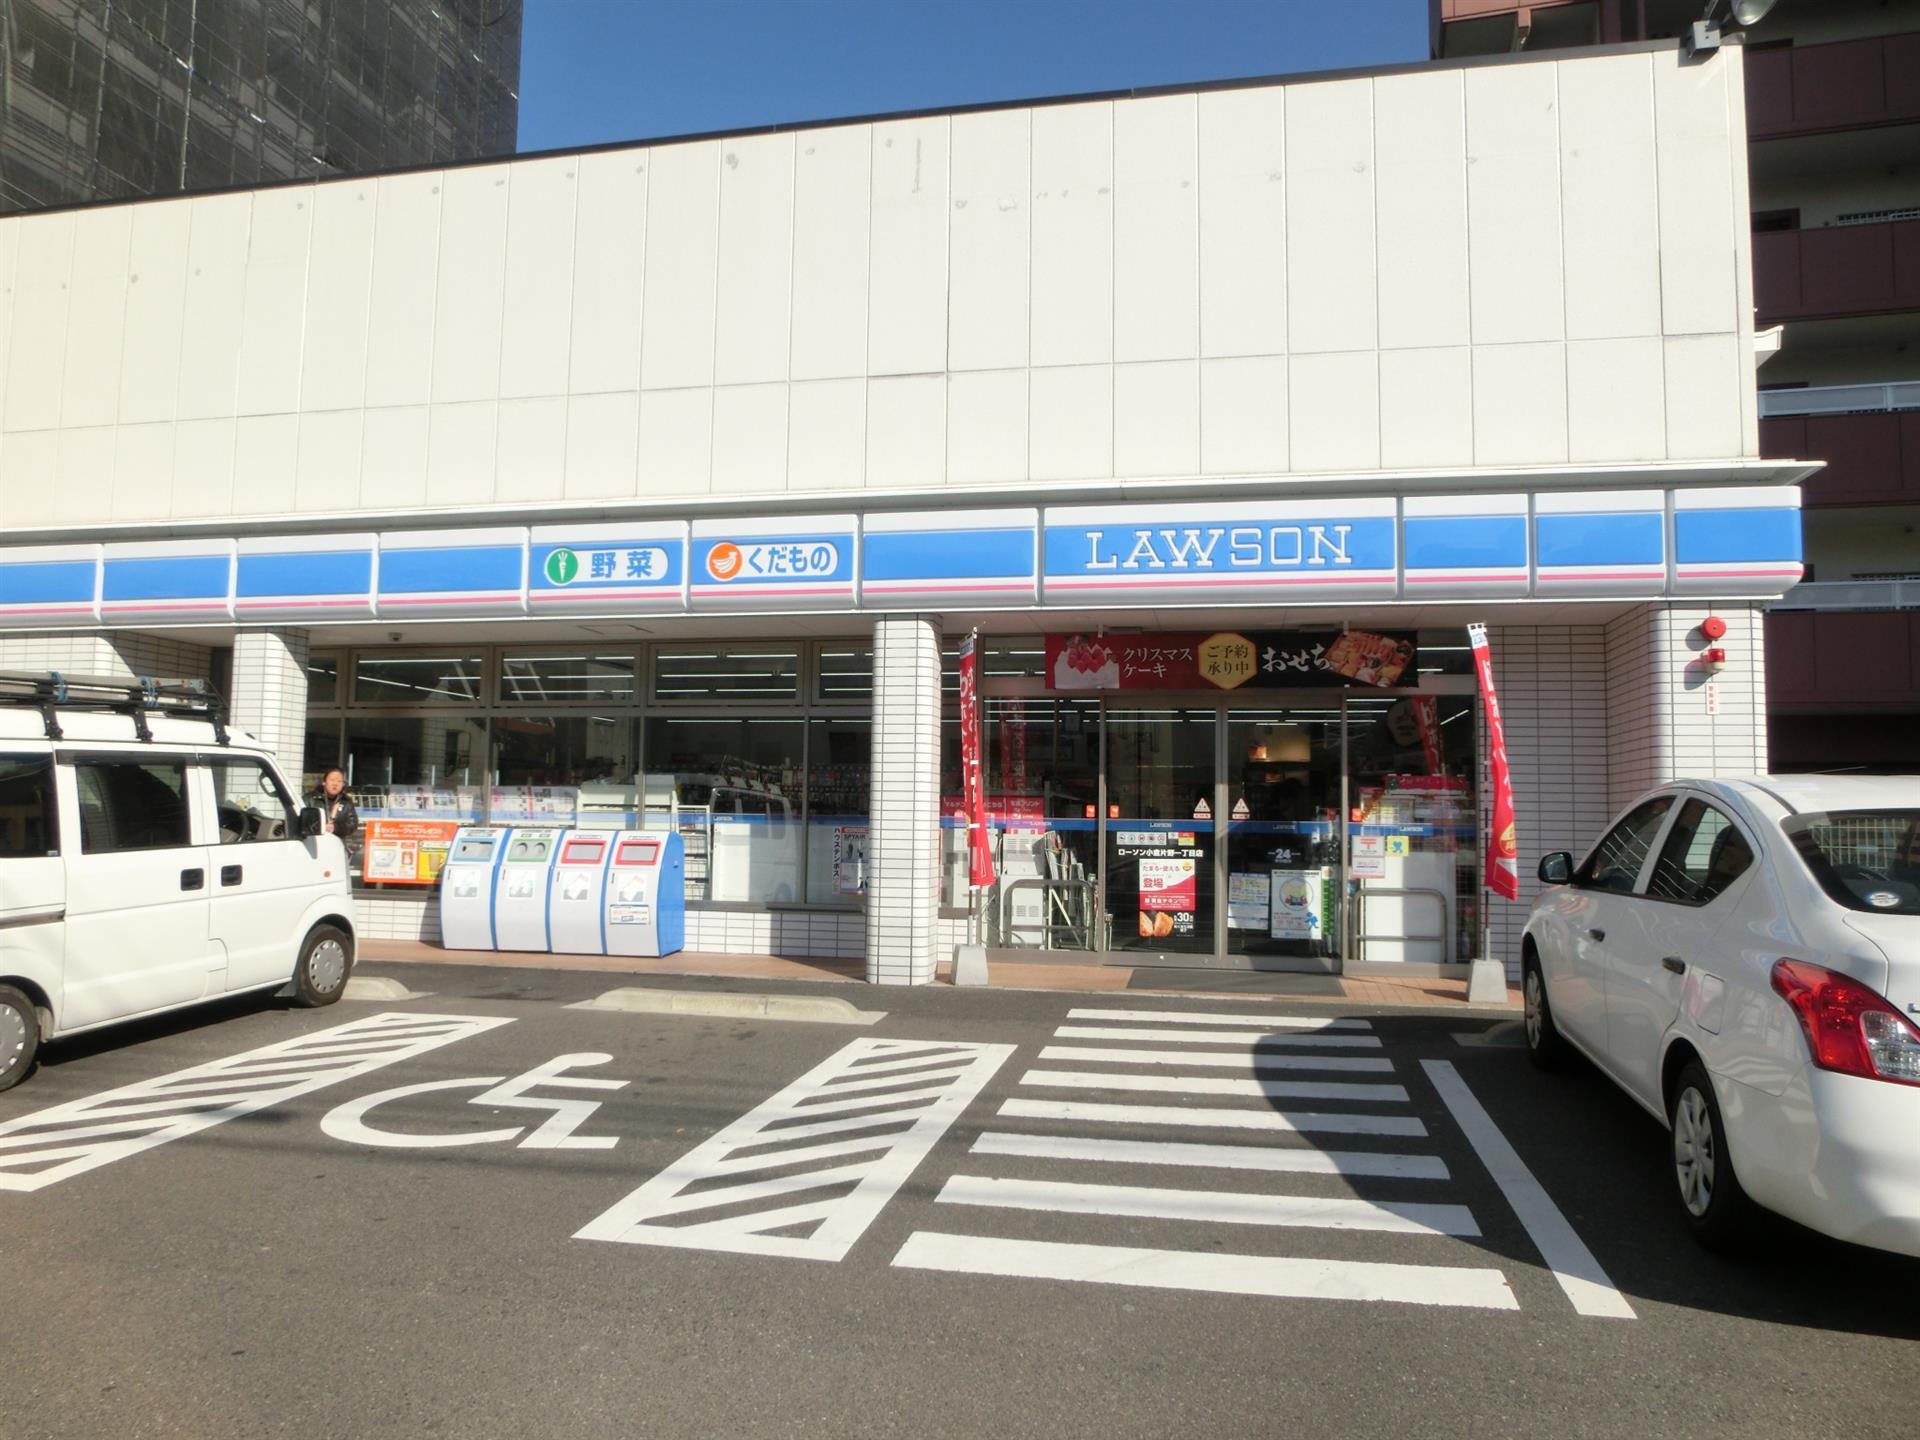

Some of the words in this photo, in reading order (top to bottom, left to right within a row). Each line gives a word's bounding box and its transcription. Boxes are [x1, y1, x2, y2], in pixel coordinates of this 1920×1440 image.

[1085, 525, 1352, 570] LAWSON
[590, 550, 653, 579] 野菜
[748, 546, 831, 574] くだもの
[1122, 646, 1193, 662] クリスマス
[1206, 644, 1249, 659] ご予約
[1262, 643, 1334, 673] おせち
[1122, 663, 1168, 678] ケーキ
[1206, 660, 1250, 676] 承り中
[1275, 848, 1291, 859] 24
